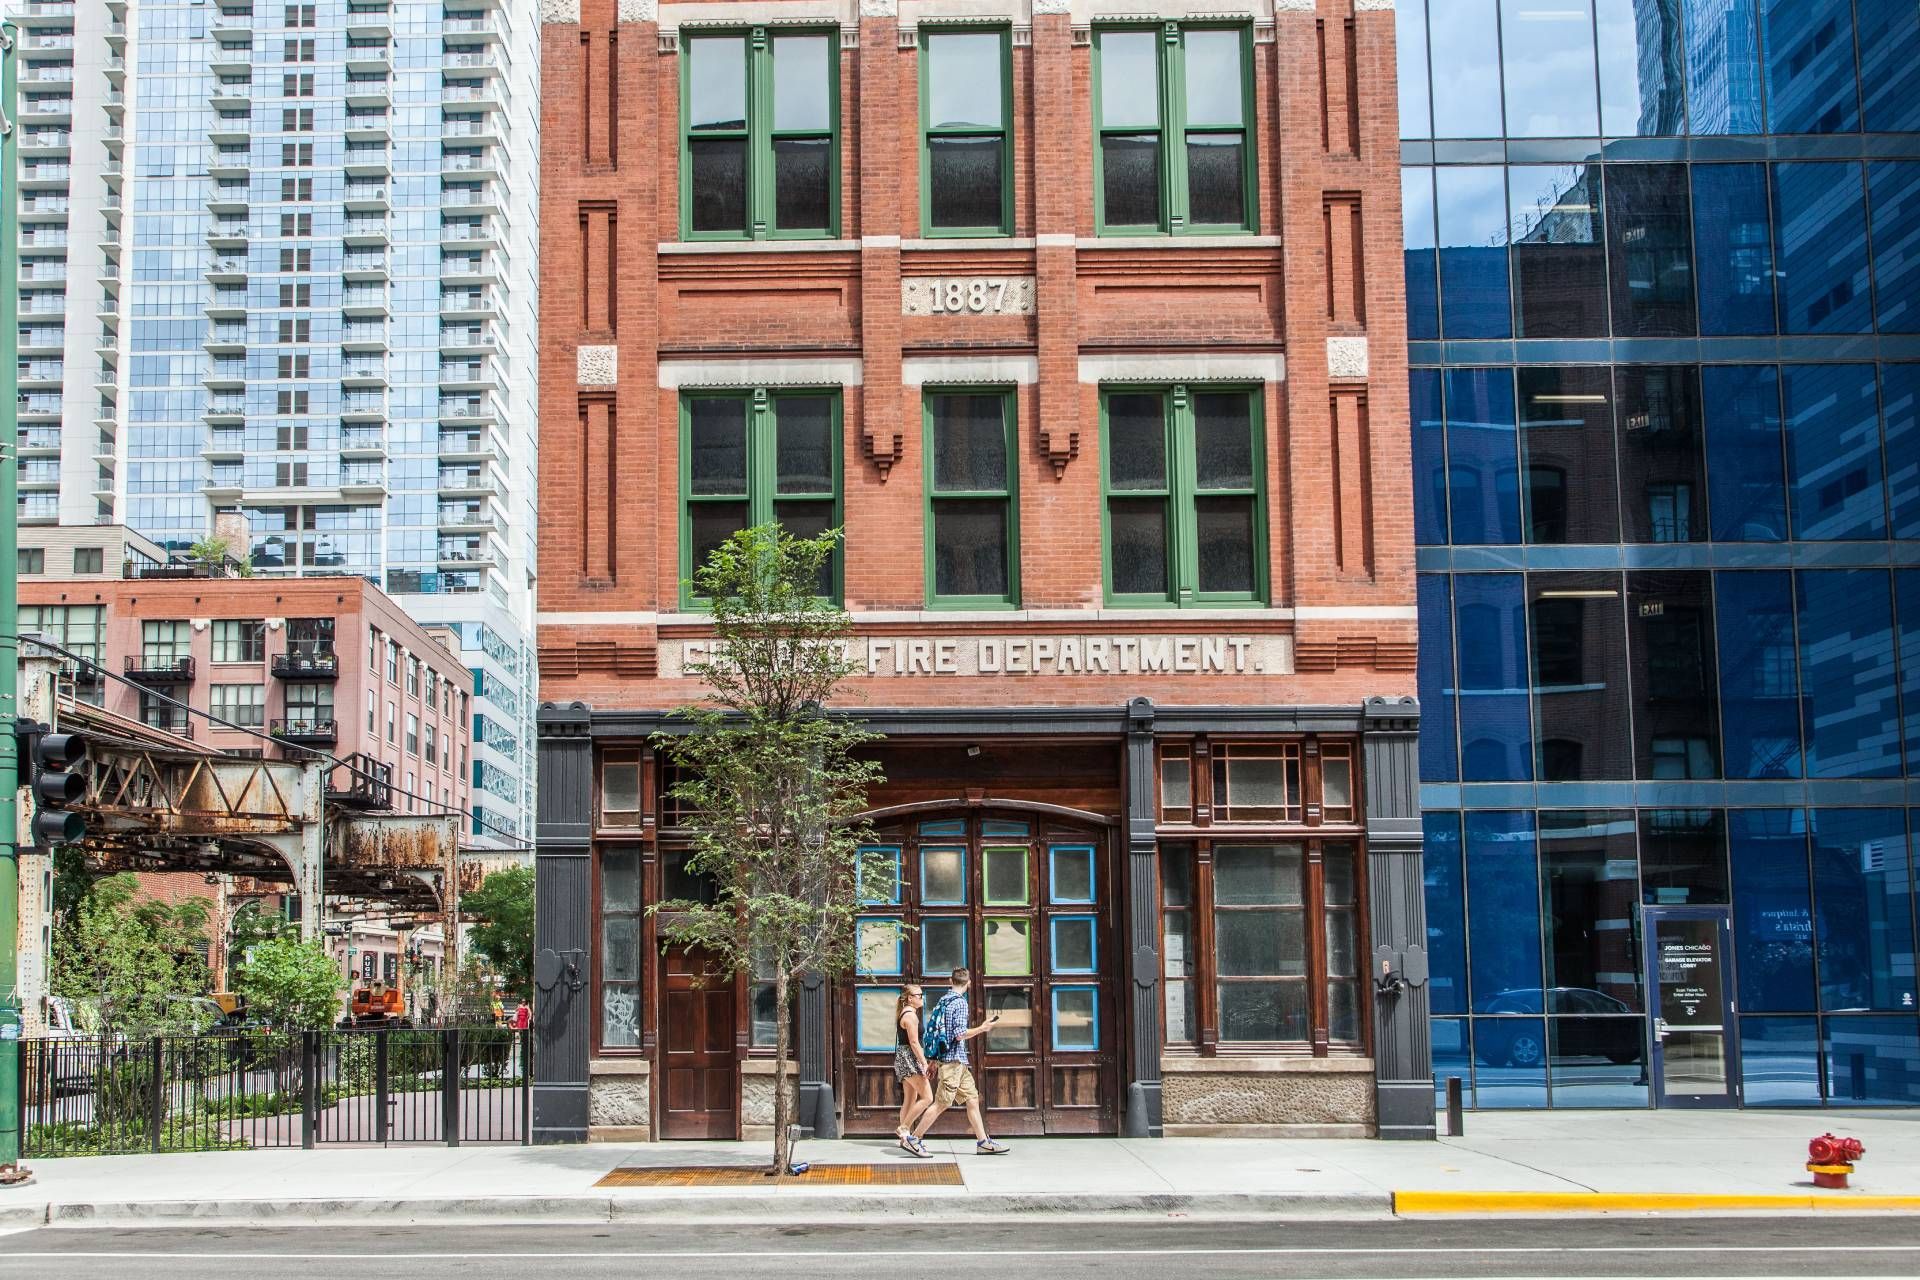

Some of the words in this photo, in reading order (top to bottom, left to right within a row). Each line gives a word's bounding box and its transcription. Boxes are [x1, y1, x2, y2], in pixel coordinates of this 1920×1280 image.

[931, 279, 1008, 312] 1887
[1628, 415, 1647, 428] EXIT
[1642, 602, 1662, 615] EXIT
[683, 640, 850, 674] CHAO
[868, 639, 957, 673] FIRE
[978, 638, 1263, 672] DEPARTMENT.
